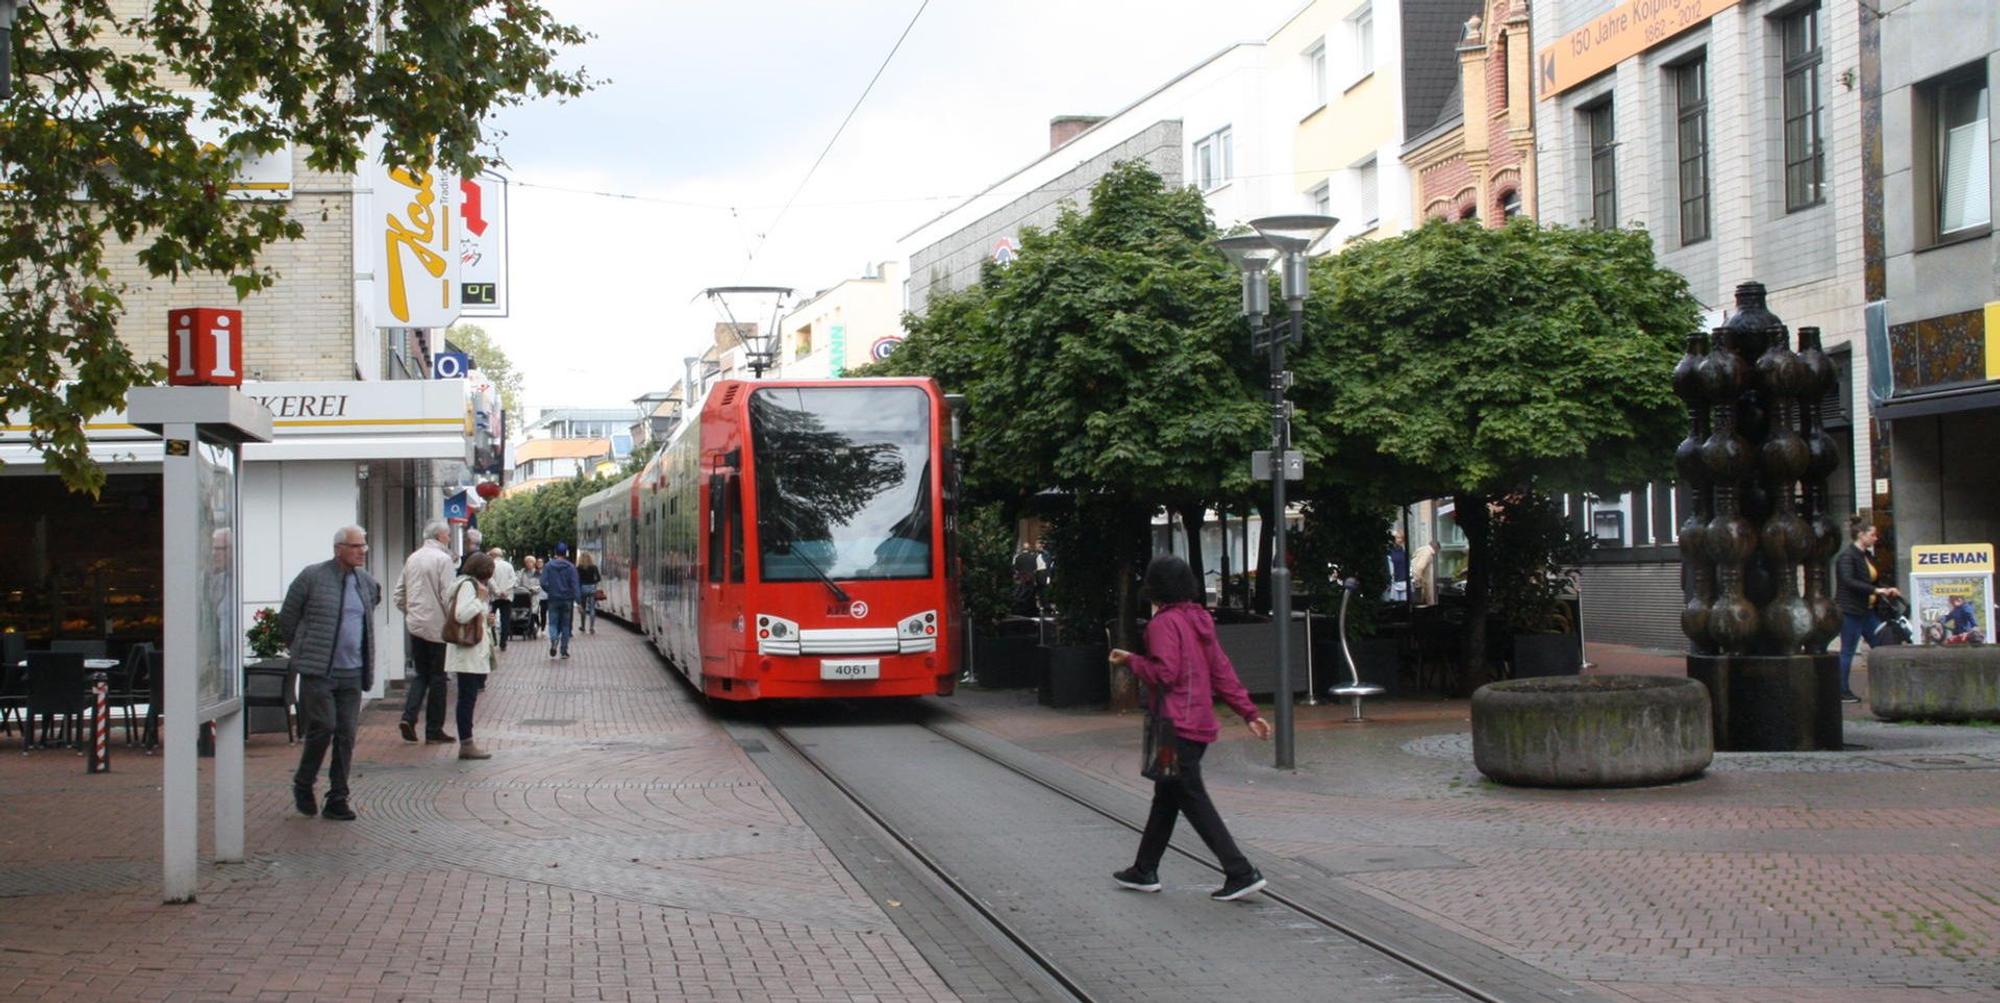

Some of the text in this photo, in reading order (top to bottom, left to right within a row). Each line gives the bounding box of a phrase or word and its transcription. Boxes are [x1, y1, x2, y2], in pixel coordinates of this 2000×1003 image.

[1644, 19, 1666, 43] 1862
[1678, 1, 1703, 27] 2012
[1571, 28, 1591, 58] 150
[1594, 13, 1628, 45] Jahre
[247, 394, 349, 418] KEREI
[1918, 552, 1987, 565] ZEEMAN
[835, 665, 867, 675] 4061
